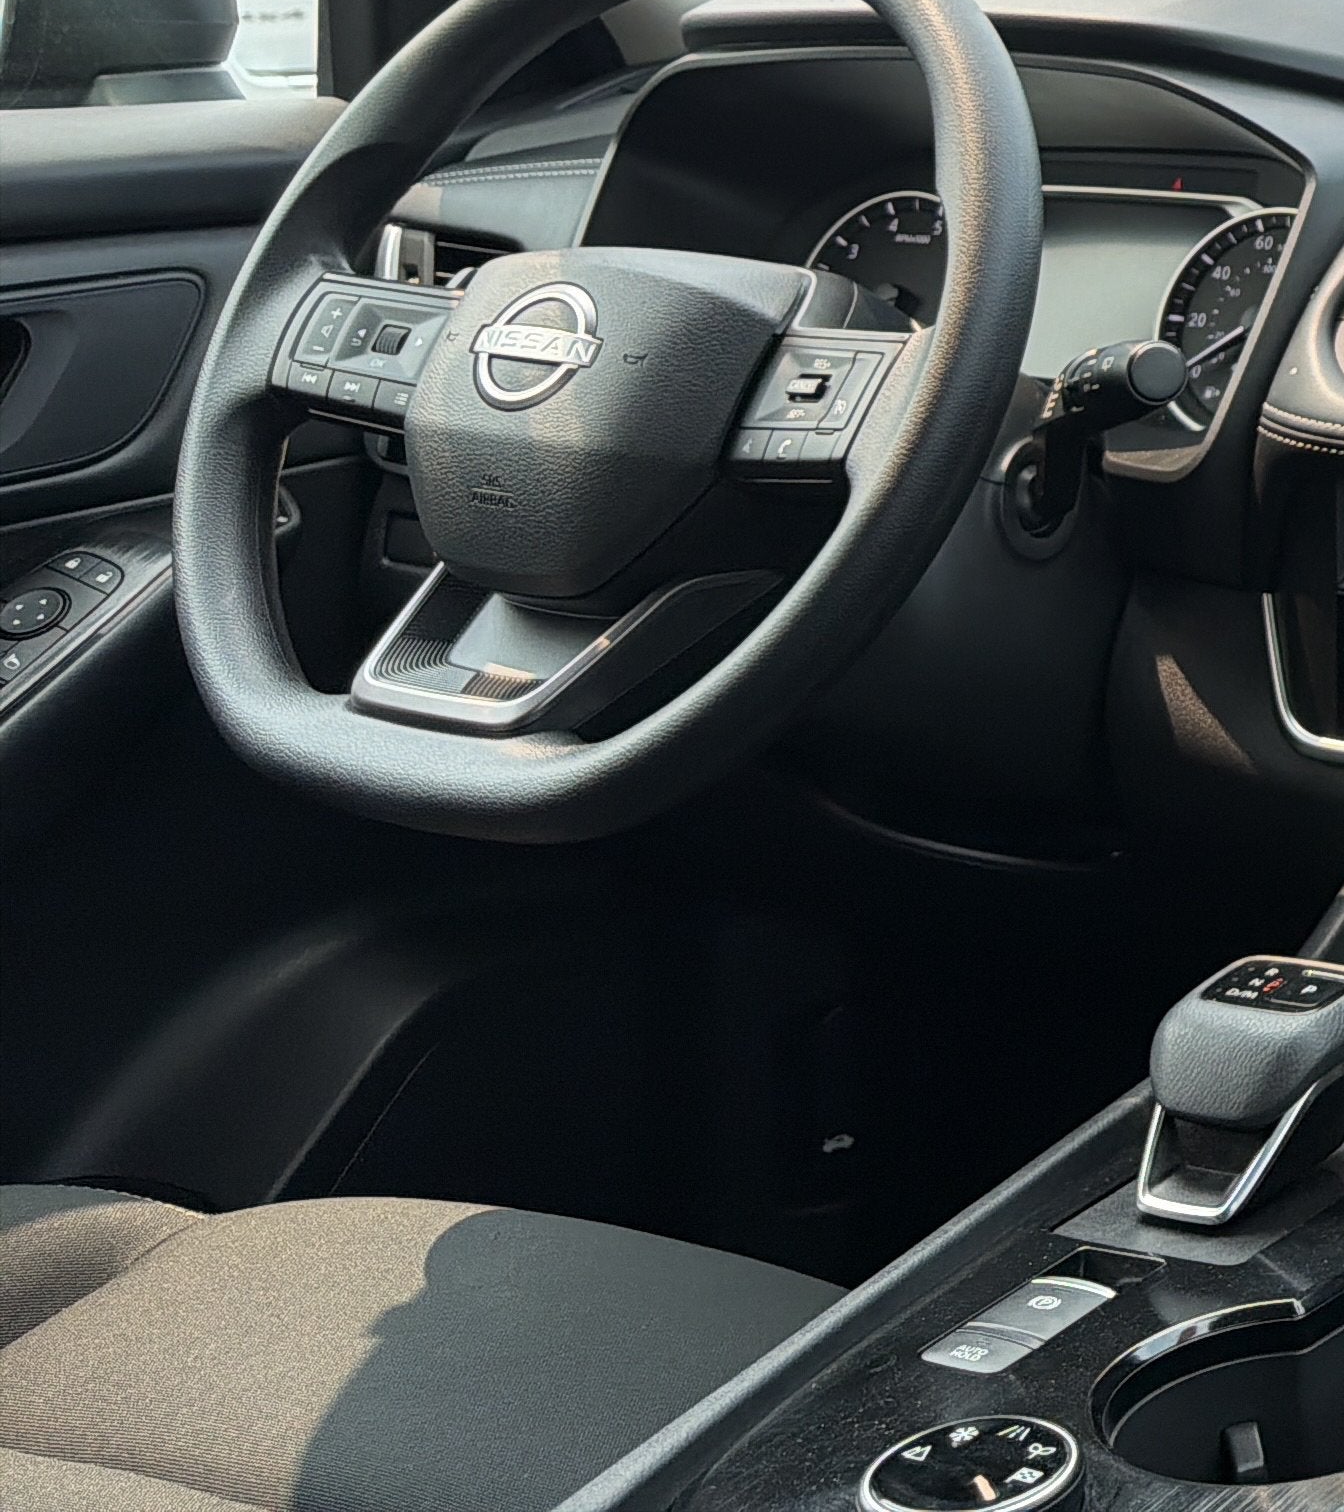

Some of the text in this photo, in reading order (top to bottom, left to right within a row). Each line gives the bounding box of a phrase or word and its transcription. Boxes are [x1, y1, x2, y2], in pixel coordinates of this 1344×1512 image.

[888, 218, 899, 232] 4
[1253, 235, 1274, 251] 60
[848, 243, 860, 260] 3
[1212, 265, 1231, 281] 40
[1187, 312, 1207, 328] 20
[480, 328, 597, 364] NISSAN
[1191, 364, 1202, 378] 0
[1300, 984, 1318, 995] P
